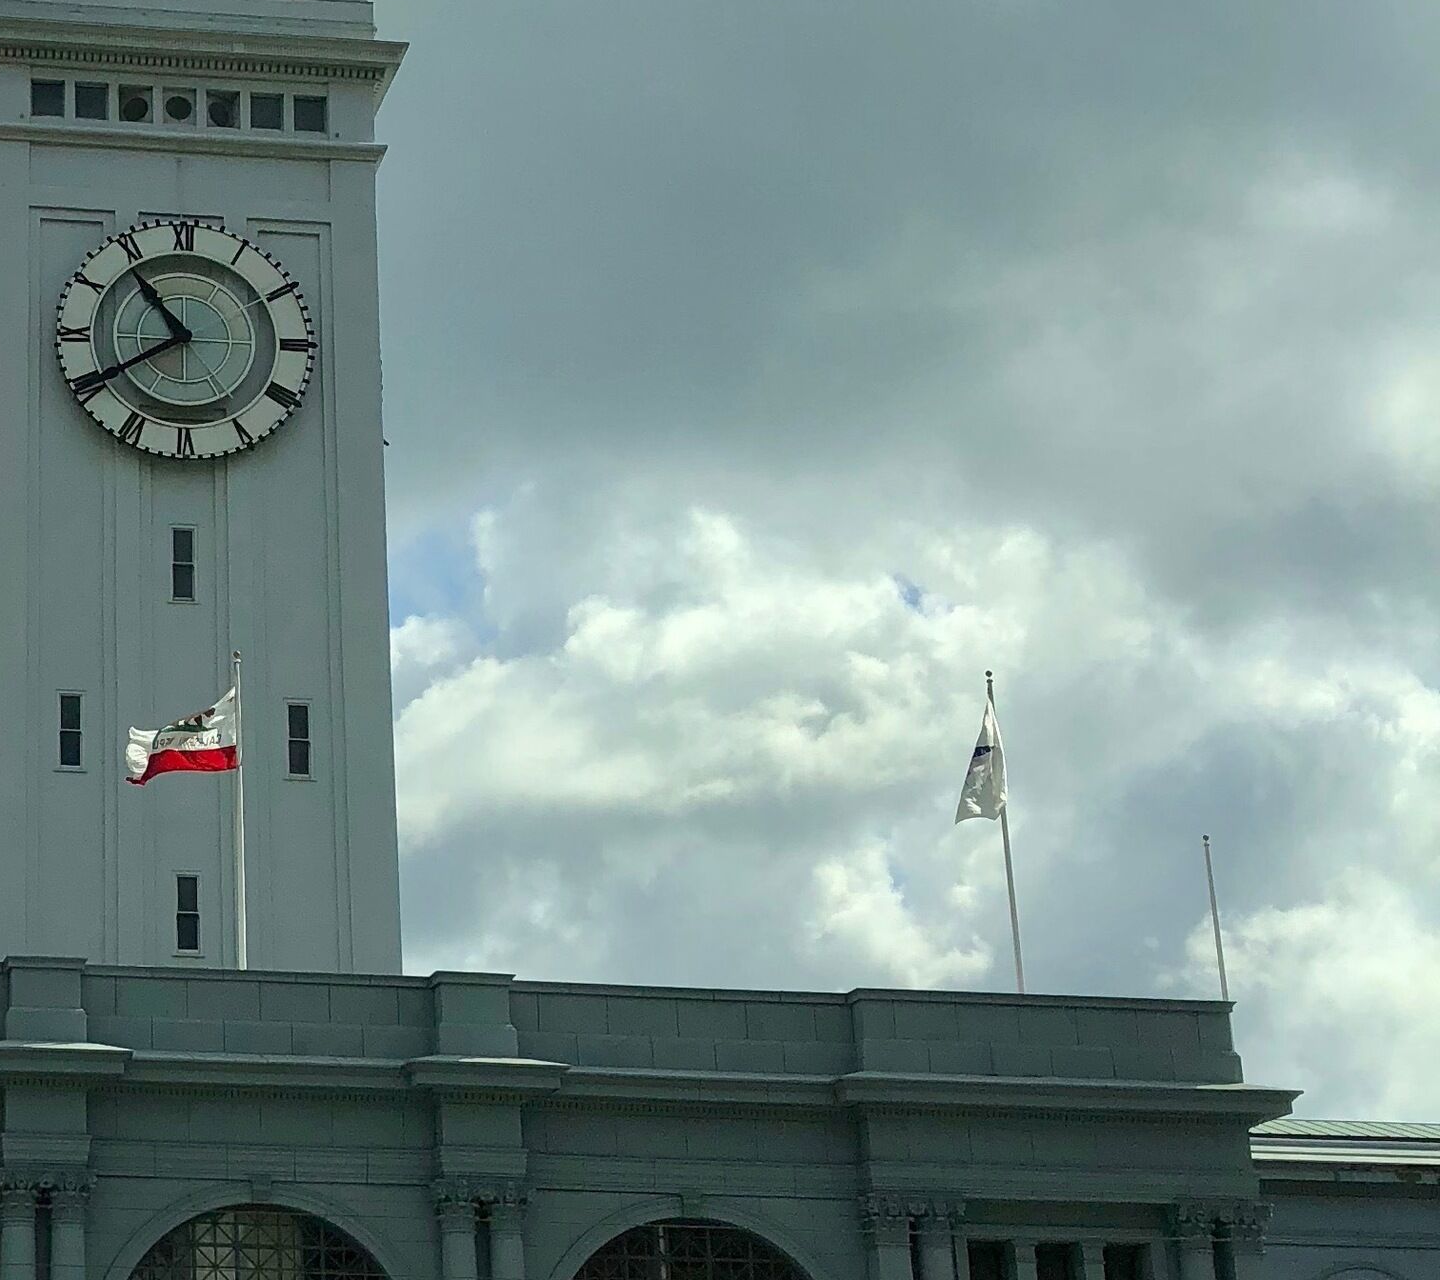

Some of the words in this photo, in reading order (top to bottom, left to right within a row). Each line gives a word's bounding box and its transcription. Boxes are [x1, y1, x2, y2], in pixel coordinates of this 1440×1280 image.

[117, 232, 143, 265] XI
[172, 222, 194, 251] XII
[59, 325, 91, 342] IX
[176, 427, 195, 456] VI
